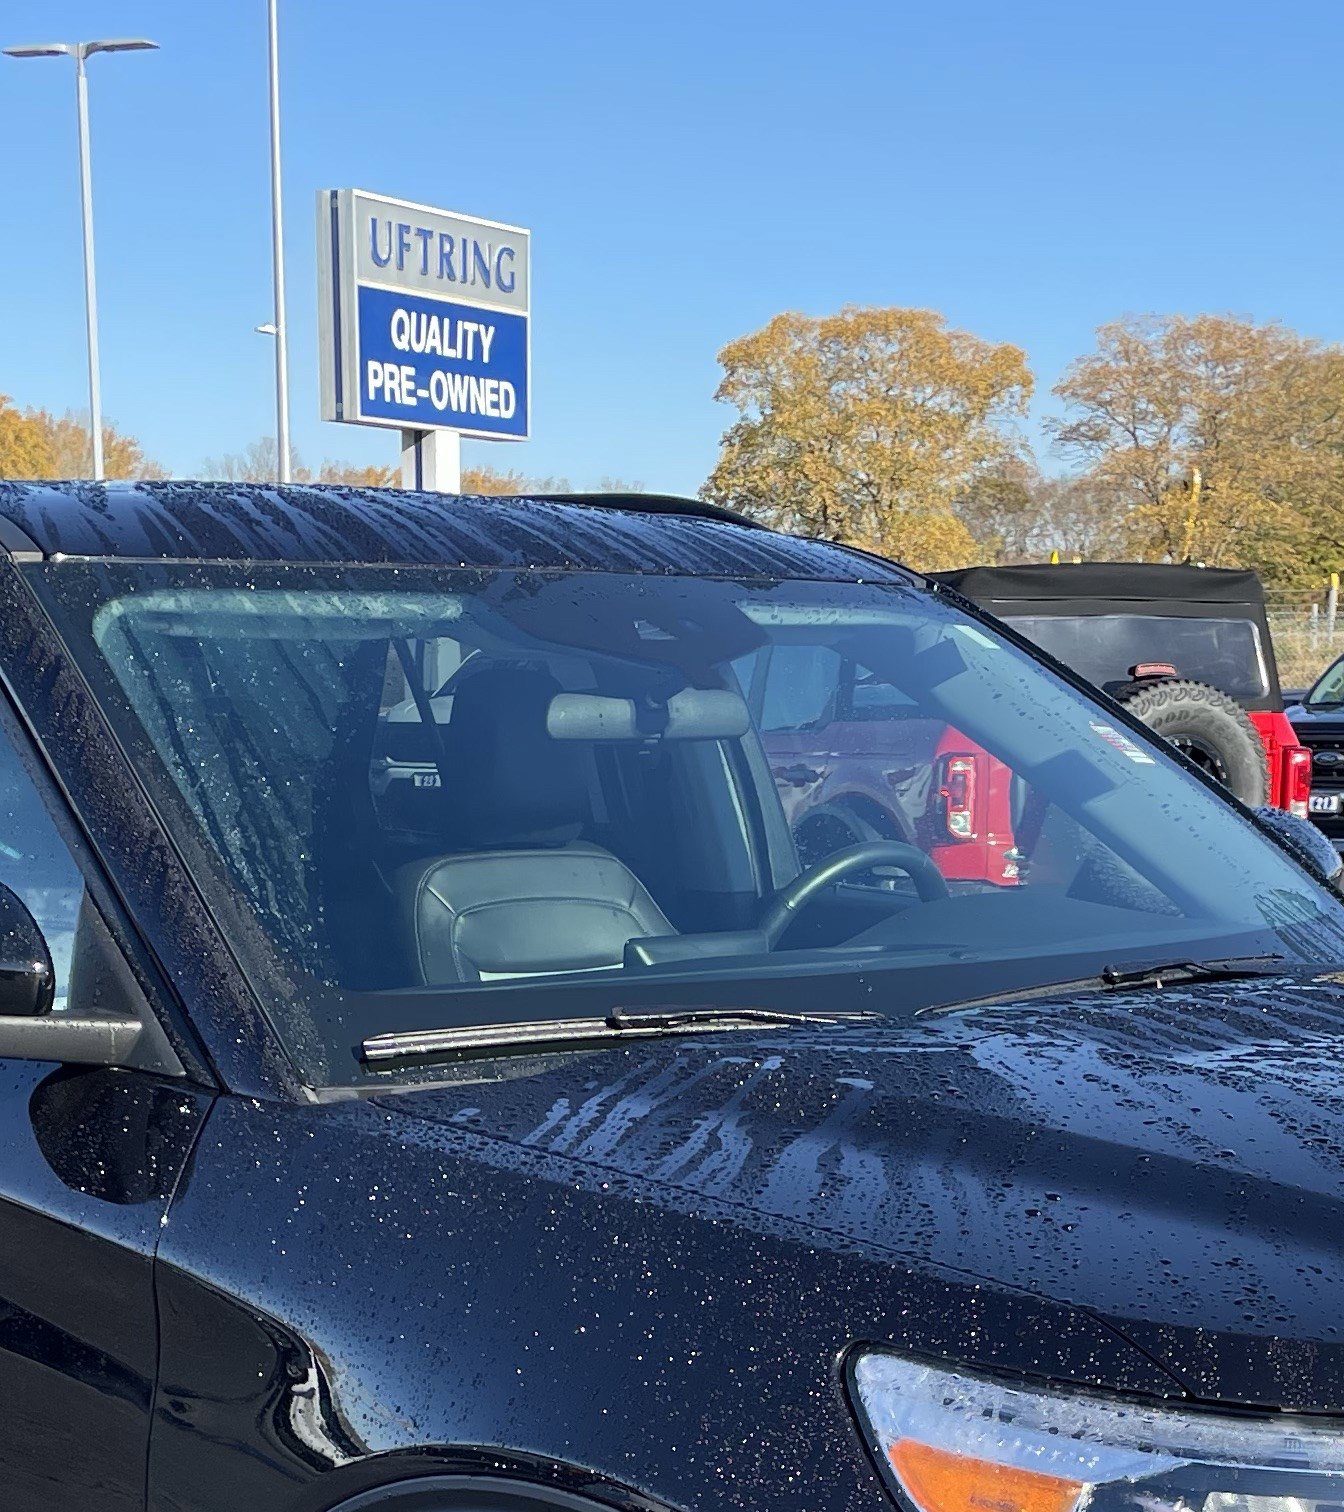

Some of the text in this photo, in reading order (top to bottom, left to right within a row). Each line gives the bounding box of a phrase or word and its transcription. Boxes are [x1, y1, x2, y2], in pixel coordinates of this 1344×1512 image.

[370, 217, 516, 293] UFTRING
[390, 308, 496, 364] QUALITY
[367, 359, 516, 420] PRE-OWNED
